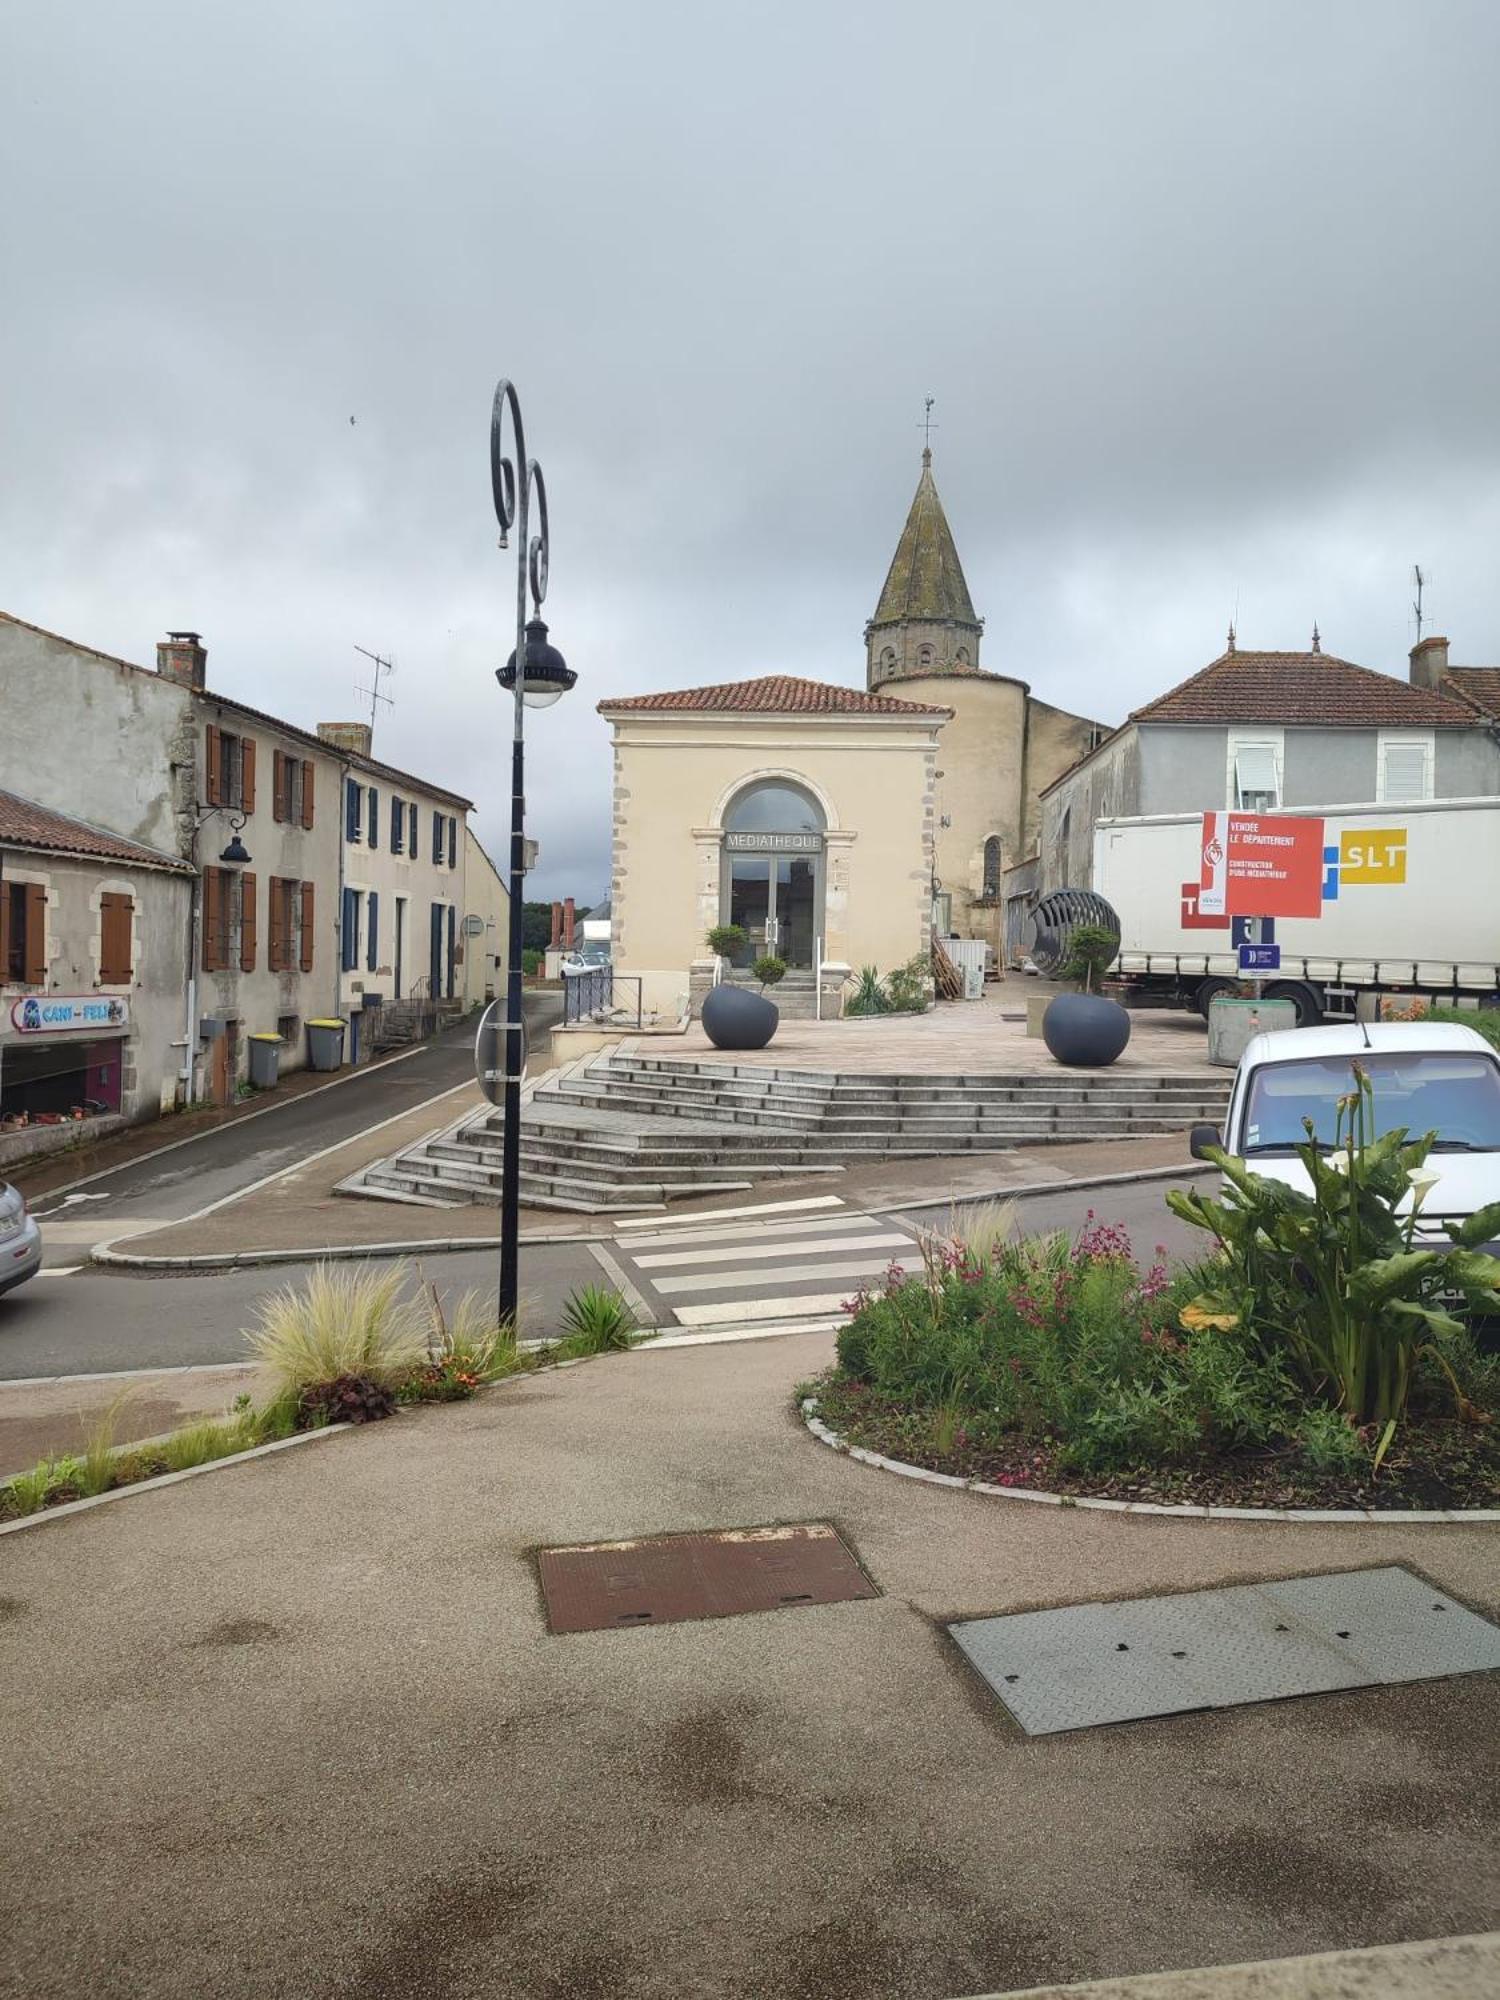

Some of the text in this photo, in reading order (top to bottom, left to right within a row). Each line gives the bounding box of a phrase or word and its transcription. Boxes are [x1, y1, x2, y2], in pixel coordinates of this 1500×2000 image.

[1229, 834, 1238, 843] LE
[1344, 846, 1405, 868] SLT
[42, 1005, 73, 1022] CANI
